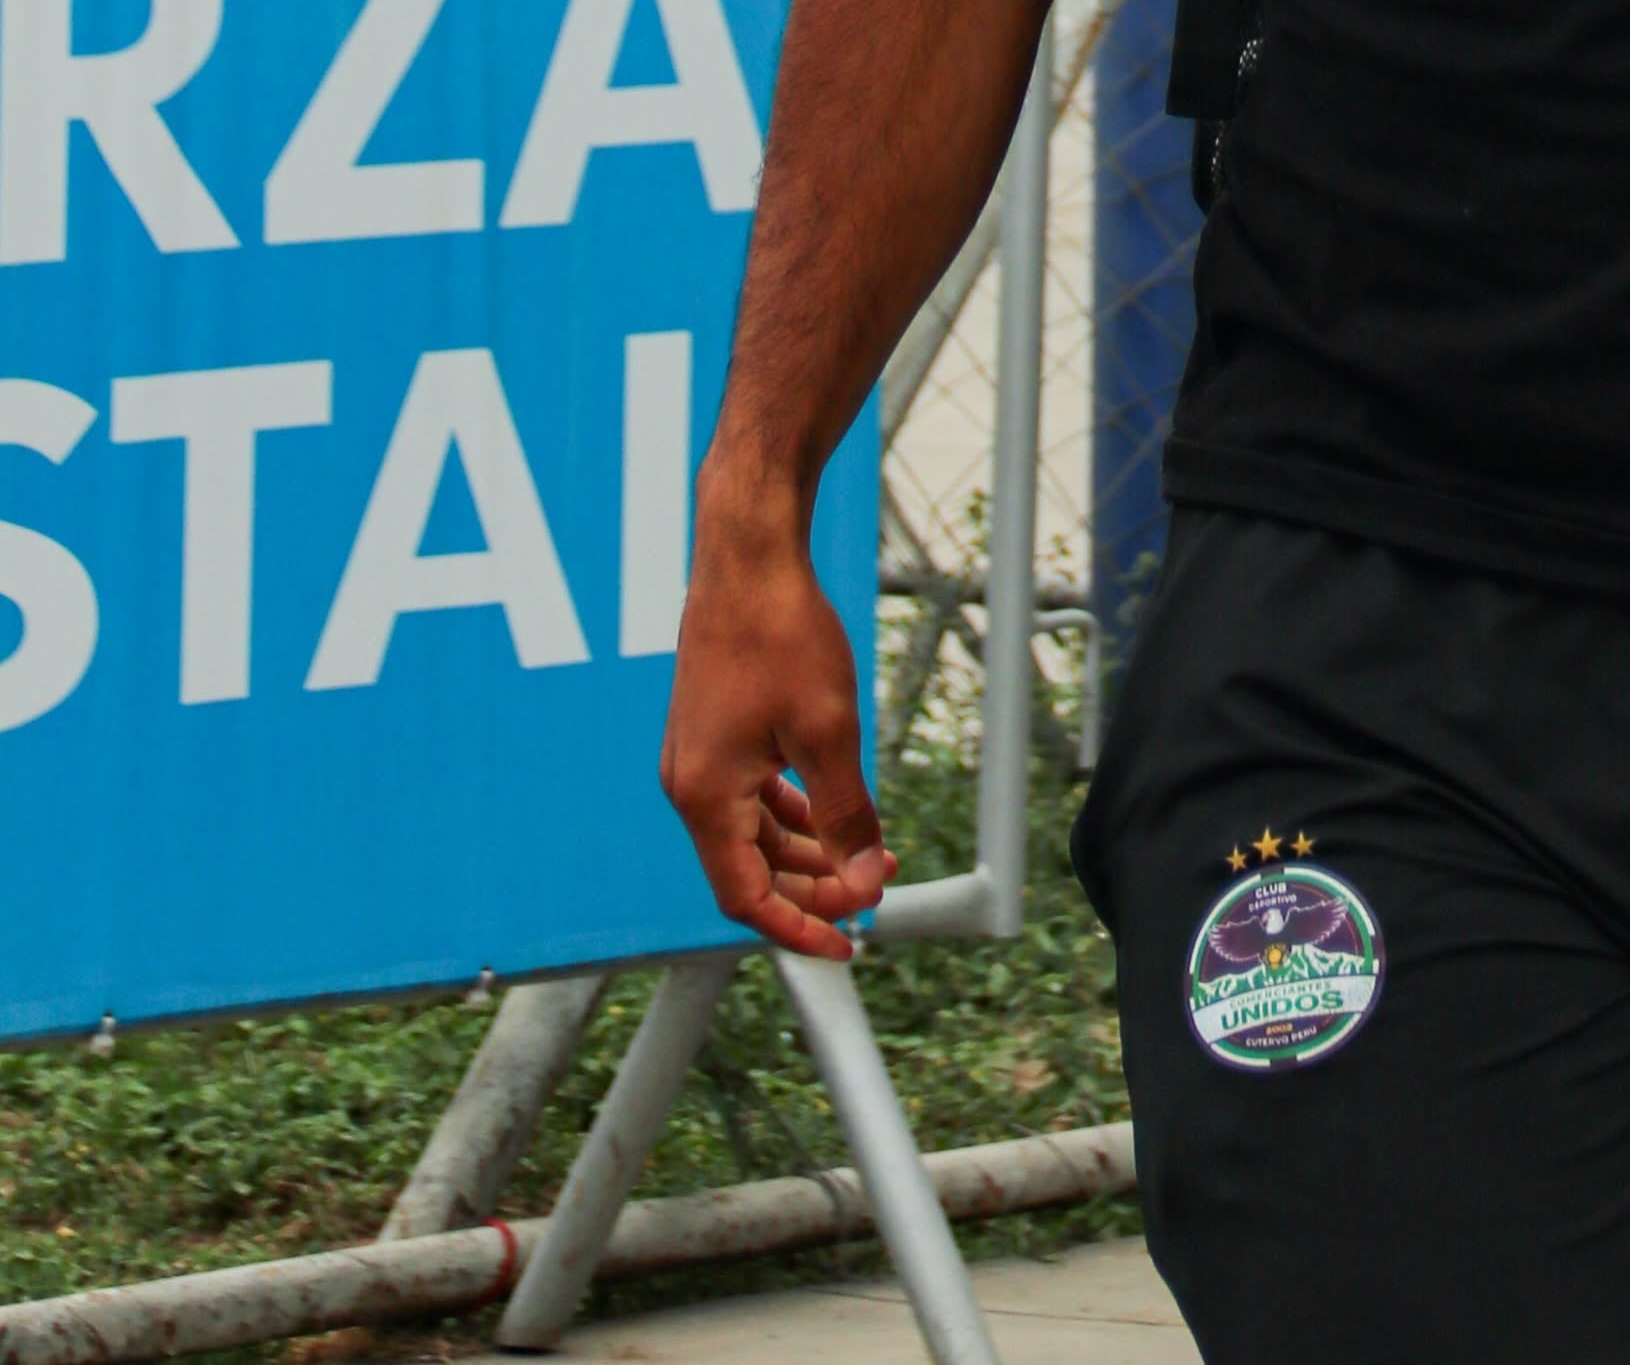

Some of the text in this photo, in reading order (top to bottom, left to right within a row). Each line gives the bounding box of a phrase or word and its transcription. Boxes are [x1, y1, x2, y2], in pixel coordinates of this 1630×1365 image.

[1255, 882, 1287, 899] CLUB
[1248, 894, 1297, 912] DEPORTIVO
[1229, 980, 1331, 1009] COMERCIANTES
[1221, 990, 1344, 1031] UNIDOS
[1246, 1035, 1289, 1047] CUTERVO
